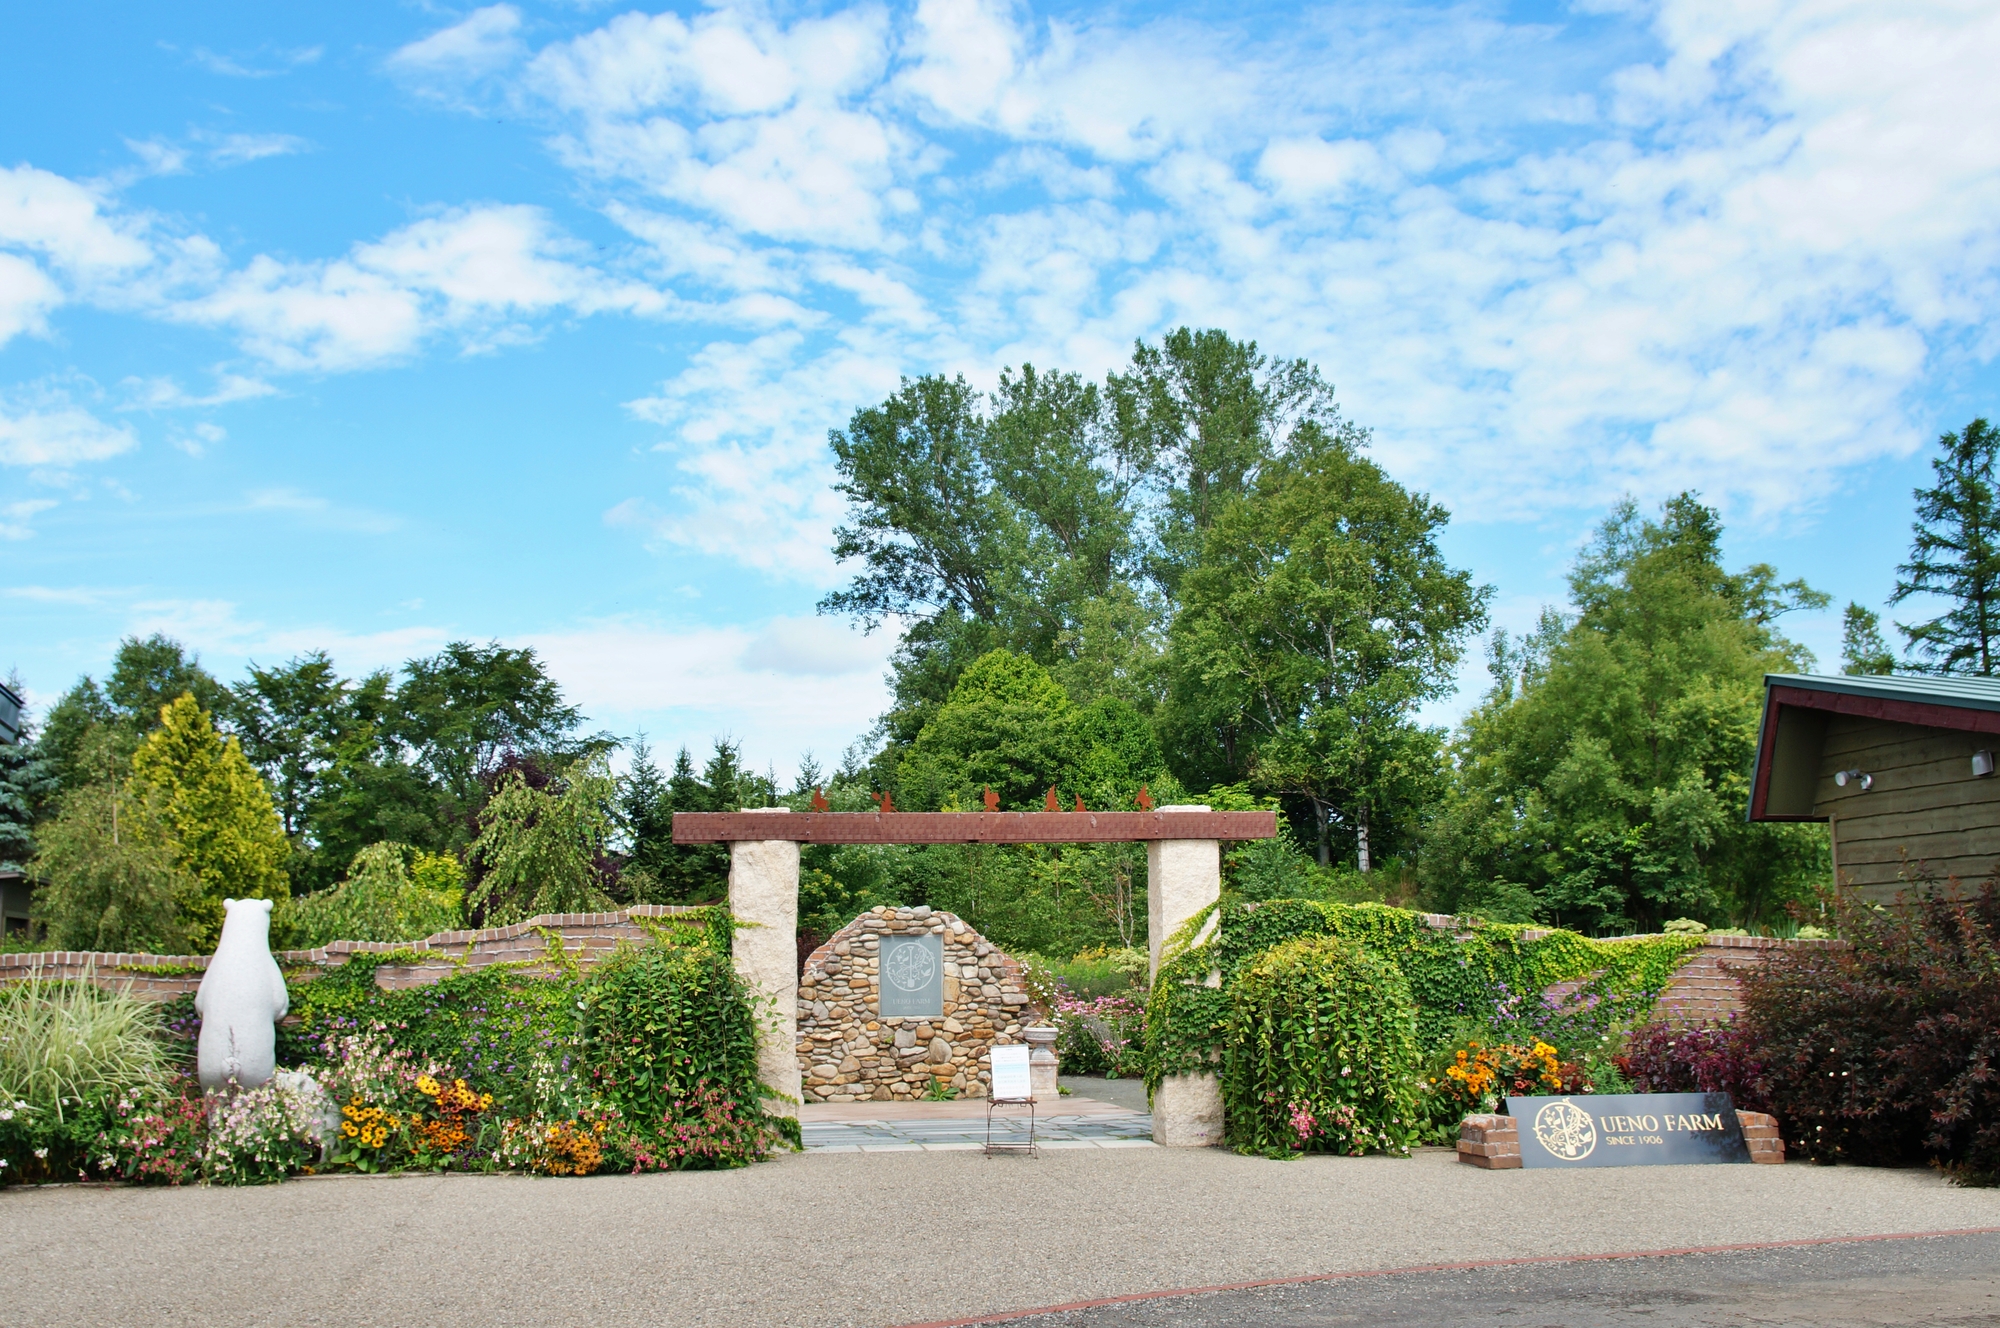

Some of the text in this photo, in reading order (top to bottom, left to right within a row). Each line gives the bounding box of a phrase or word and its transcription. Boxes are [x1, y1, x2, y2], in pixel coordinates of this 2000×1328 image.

[1600, 1113, 1725, 1132] UENO FARM
[1605, 1135, 1664, 1146] SINCE 1906
